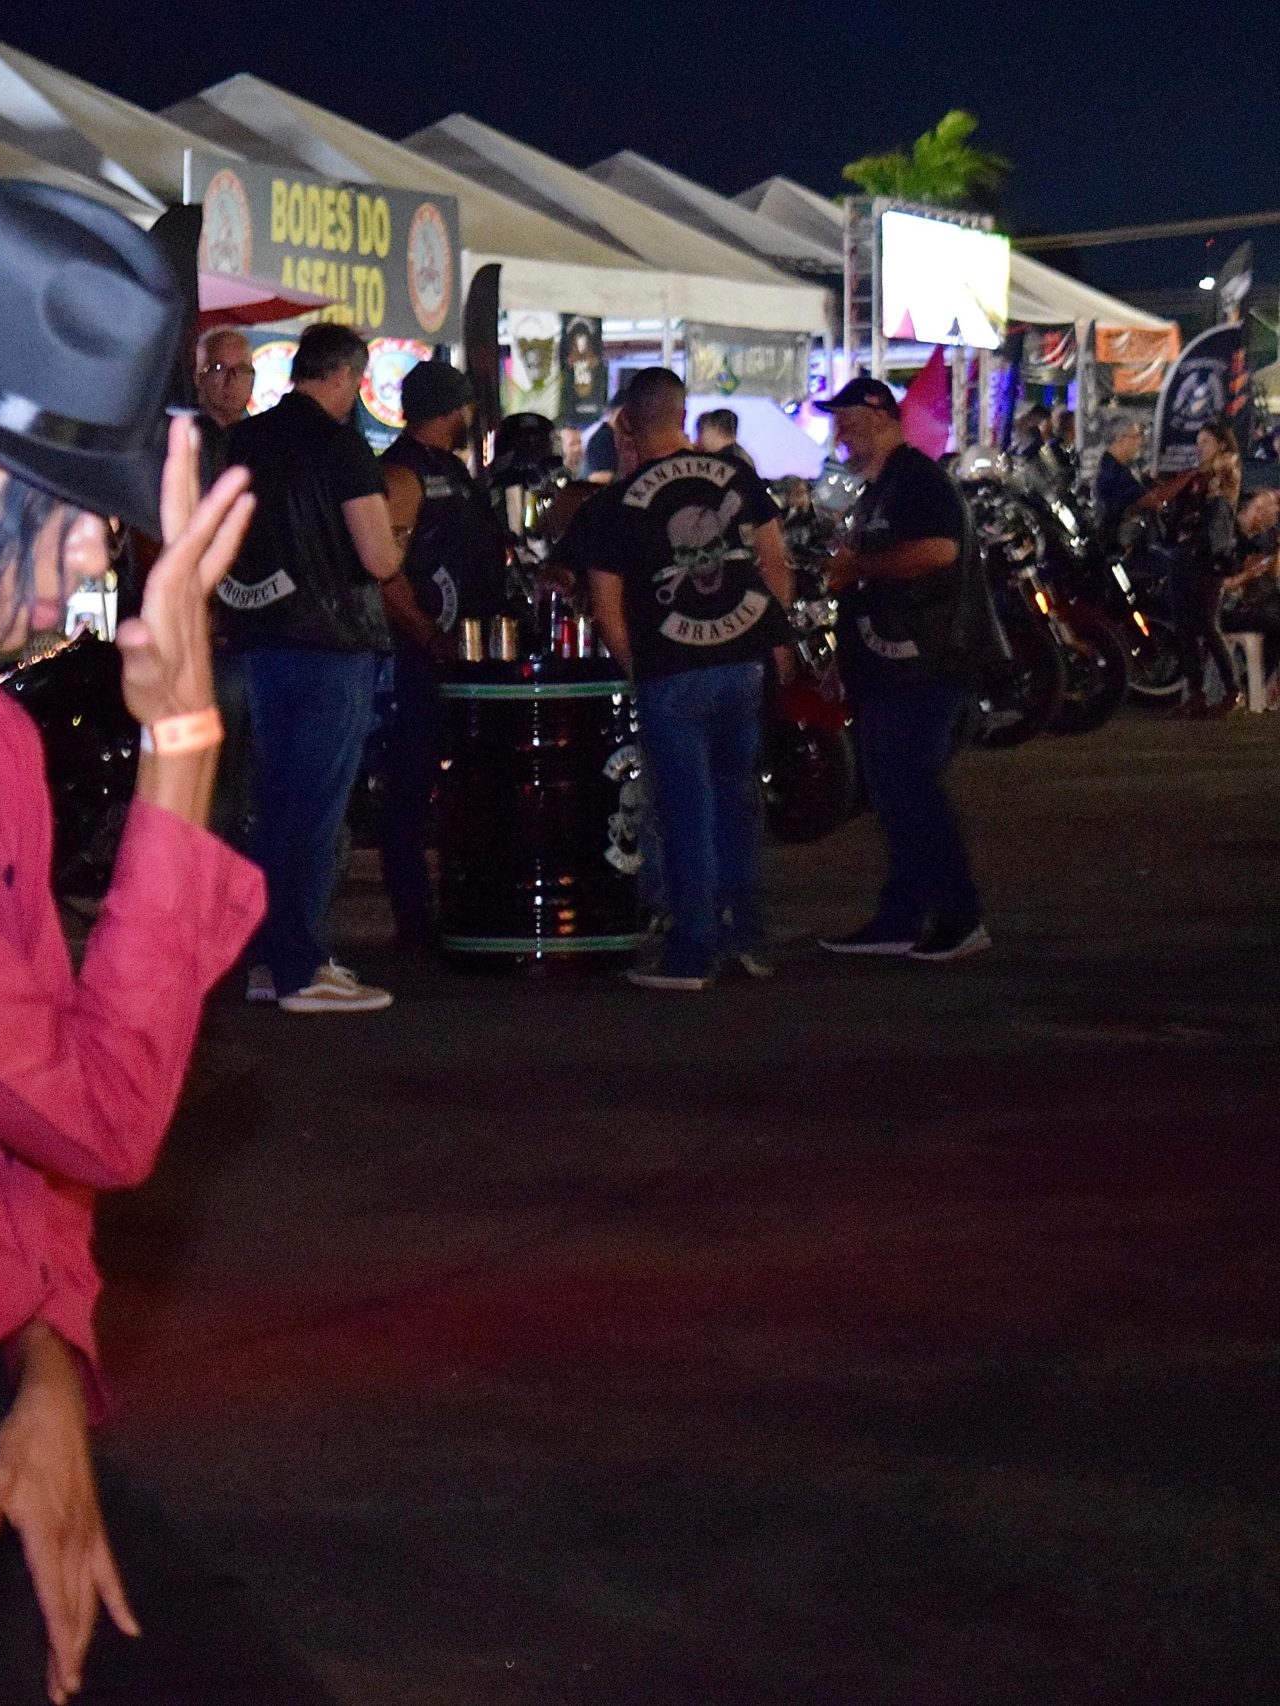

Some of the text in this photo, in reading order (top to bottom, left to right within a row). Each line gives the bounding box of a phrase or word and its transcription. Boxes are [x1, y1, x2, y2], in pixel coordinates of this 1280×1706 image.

[271, 178, 353, 253] BODES
[356, 194, 391, 258] DO
[630, 460, 727, 501] KANAIMA
[677, 601, 758, 641] BRASIL
